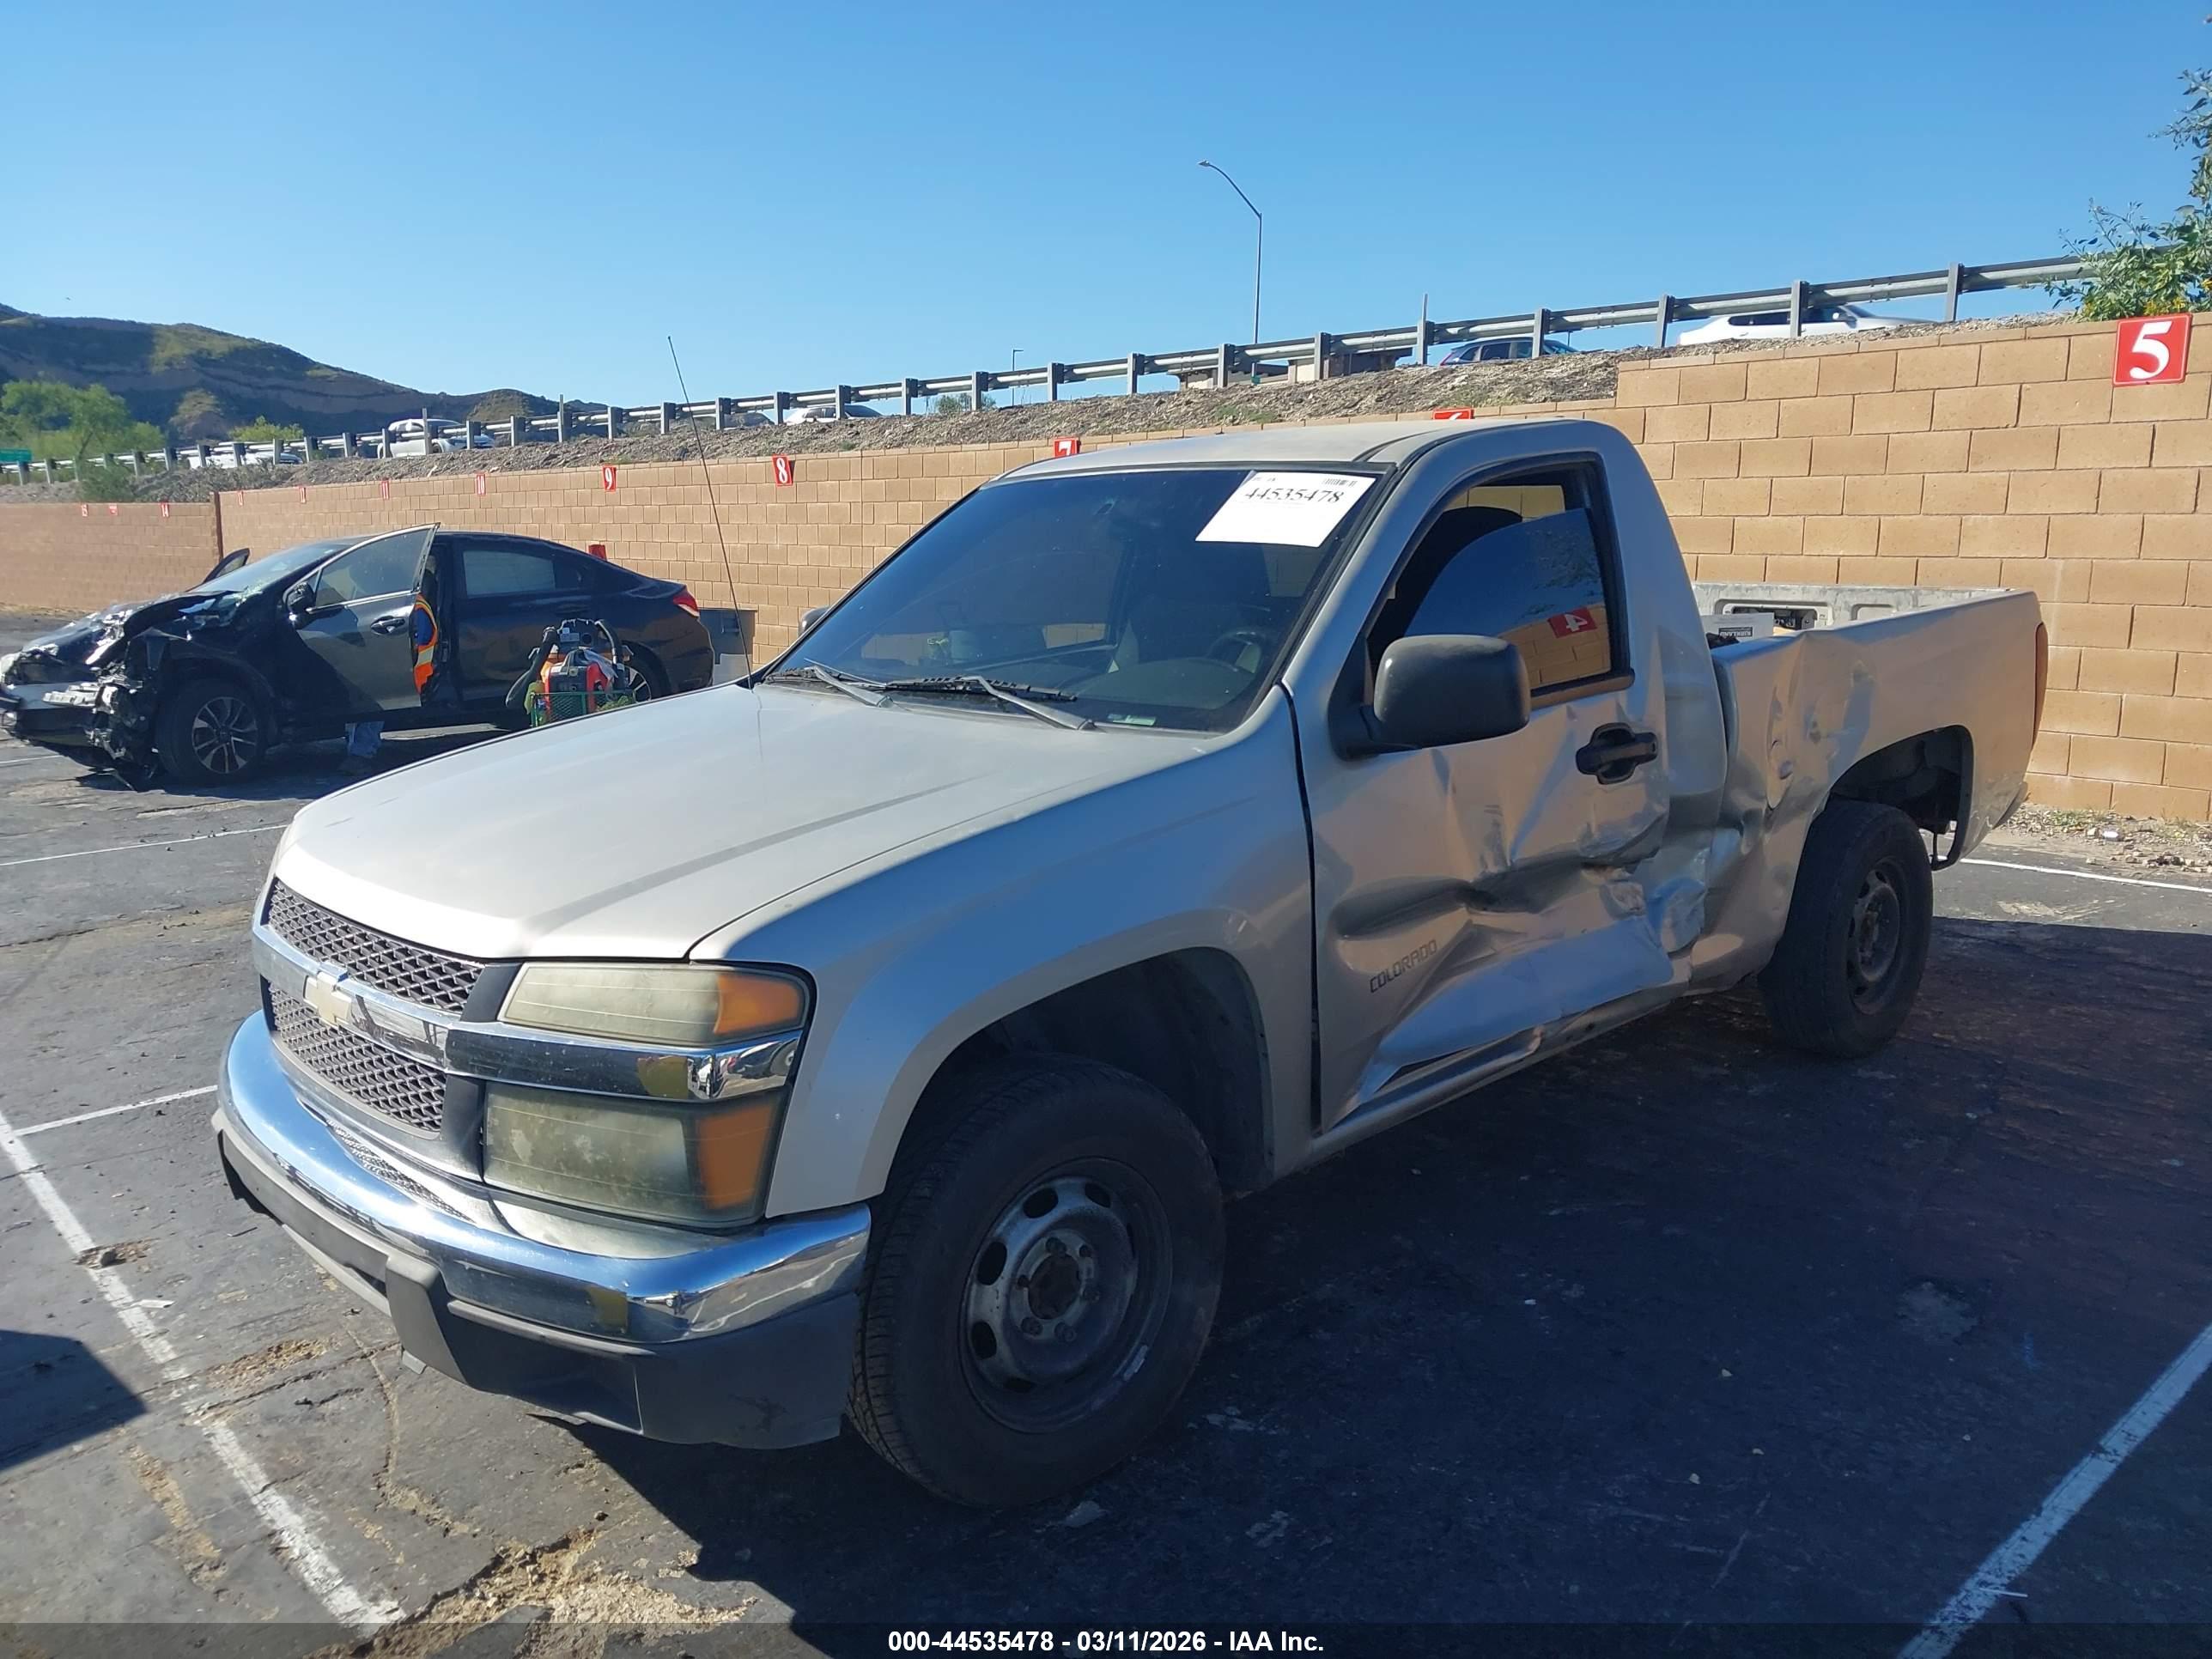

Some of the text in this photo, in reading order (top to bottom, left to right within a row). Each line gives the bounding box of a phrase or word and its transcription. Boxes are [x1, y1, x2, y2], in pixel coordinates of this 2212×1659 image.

[2130, 320, 2172, 379] 5
[605, 467, 612, 490] 9
[776, 457, 788, 483] 8
[1244, 487, 1345, 503] 44535478
[1370, 939, 1437, 994] COLORADO
